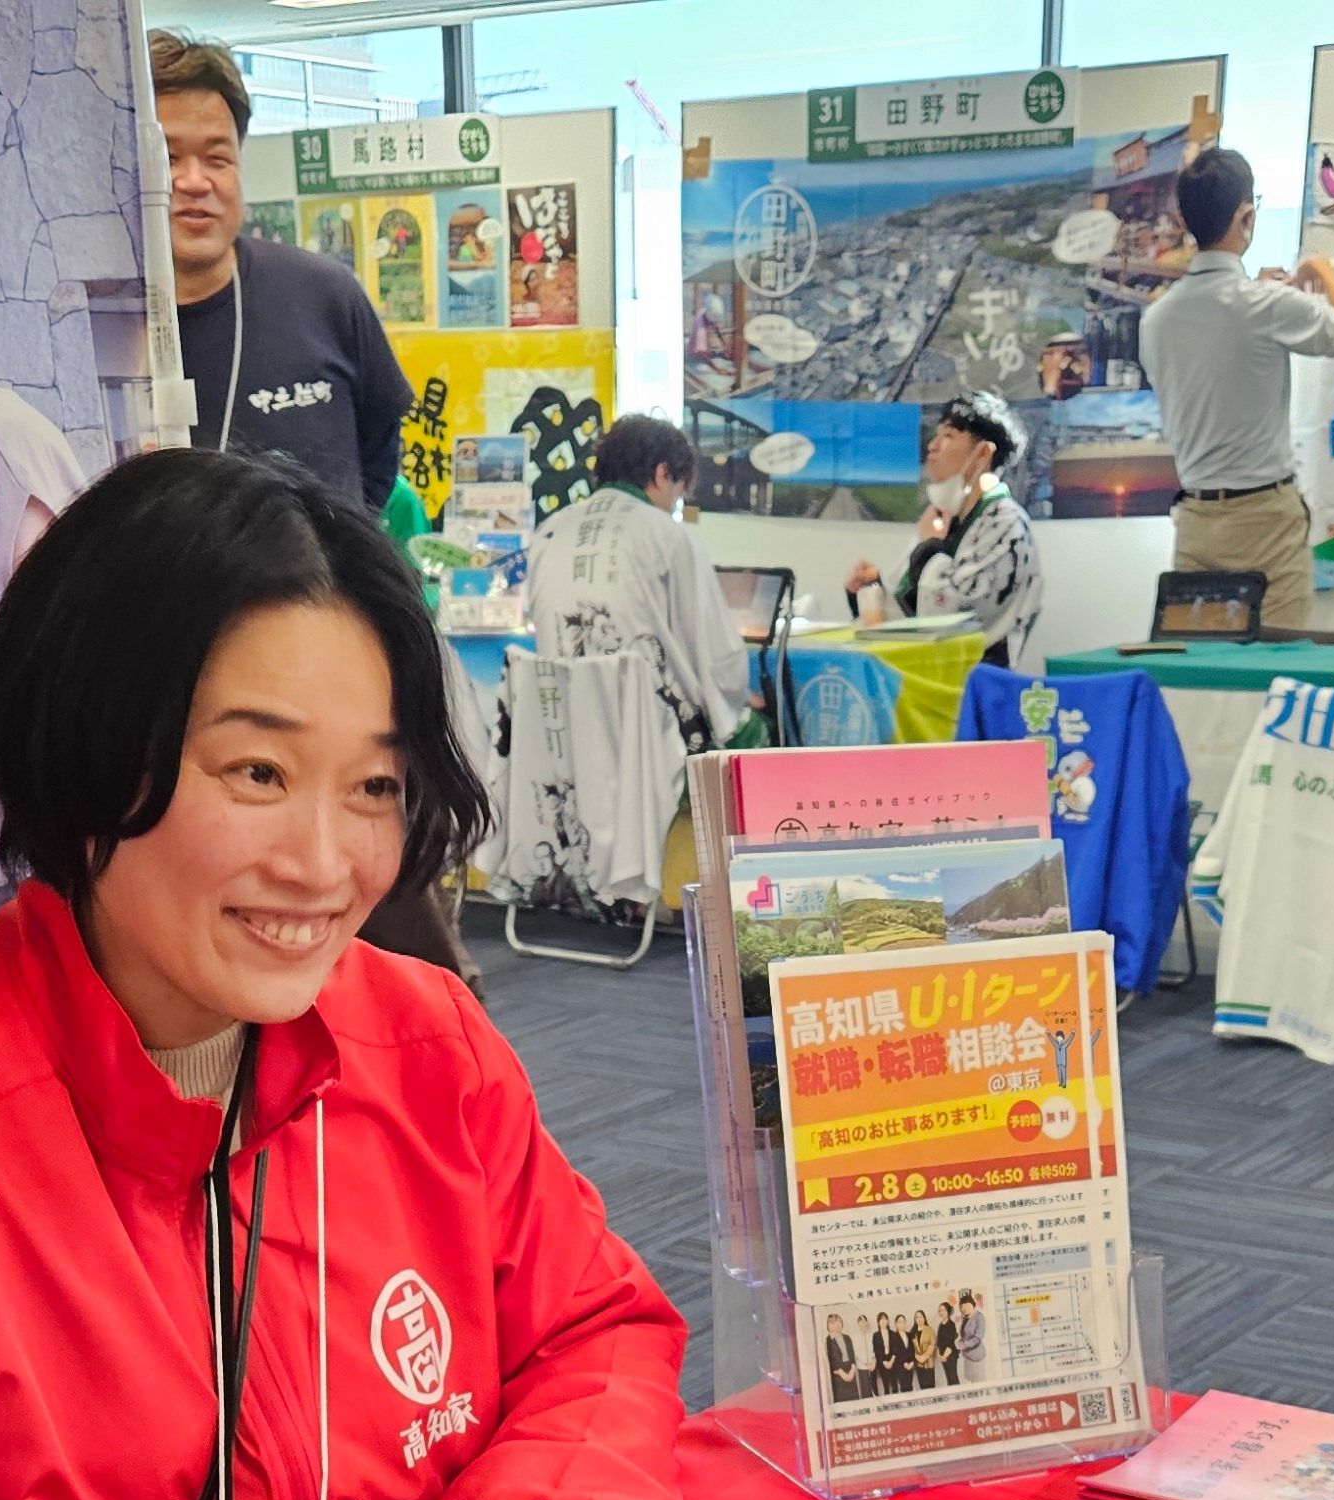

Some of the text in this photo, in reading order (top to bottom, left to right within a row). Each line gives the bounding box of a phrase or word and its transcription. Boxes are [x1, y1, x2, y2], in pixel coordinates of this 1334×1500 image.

[818, 96, 843, 124] 31
[887, 93, 981, 125] 田野町
[299, 135, 322, 161] 30
[988, 1067, 1044, 1095] @東京
[399, 1391, 480, 1469] 高知家
